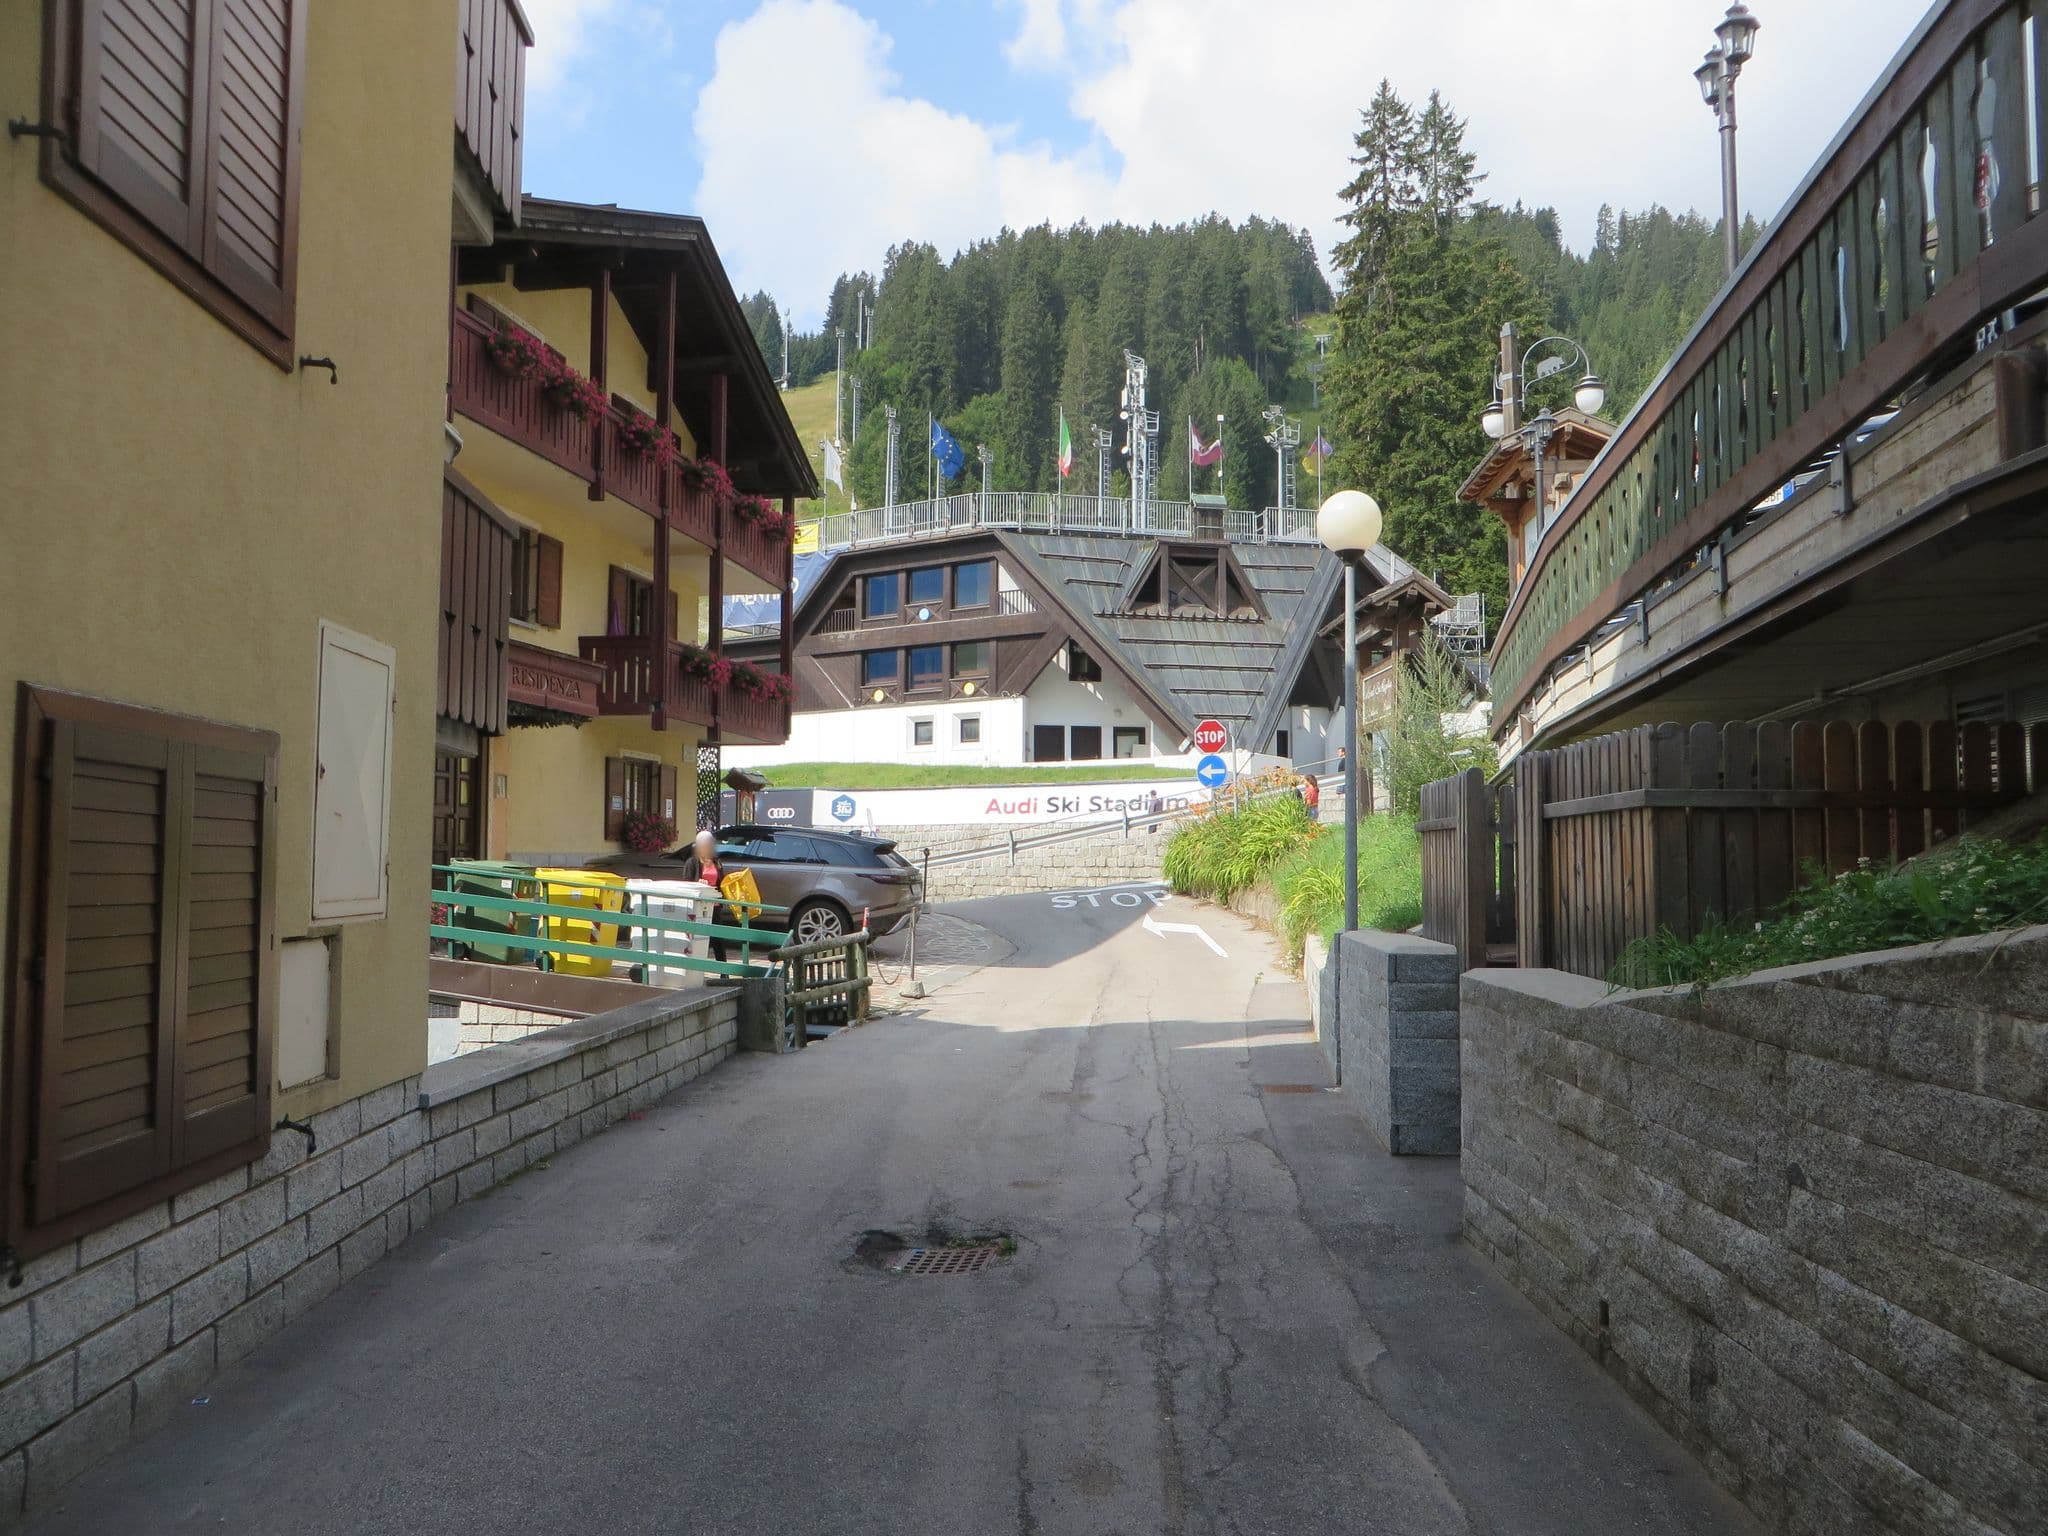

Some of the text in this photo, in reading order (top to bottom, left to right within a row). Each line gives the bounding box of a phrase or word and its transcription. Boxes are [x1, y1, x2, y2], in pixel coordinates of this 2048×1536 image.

[512, 665, 581, 698] RESIDENZA
[1196, 730, 1224, 744] STOP
[985, 798, 1038, 815] Audi
[1046, 796, 1080, 813] Ski
[1051, 889, 1173, 908] STOP
